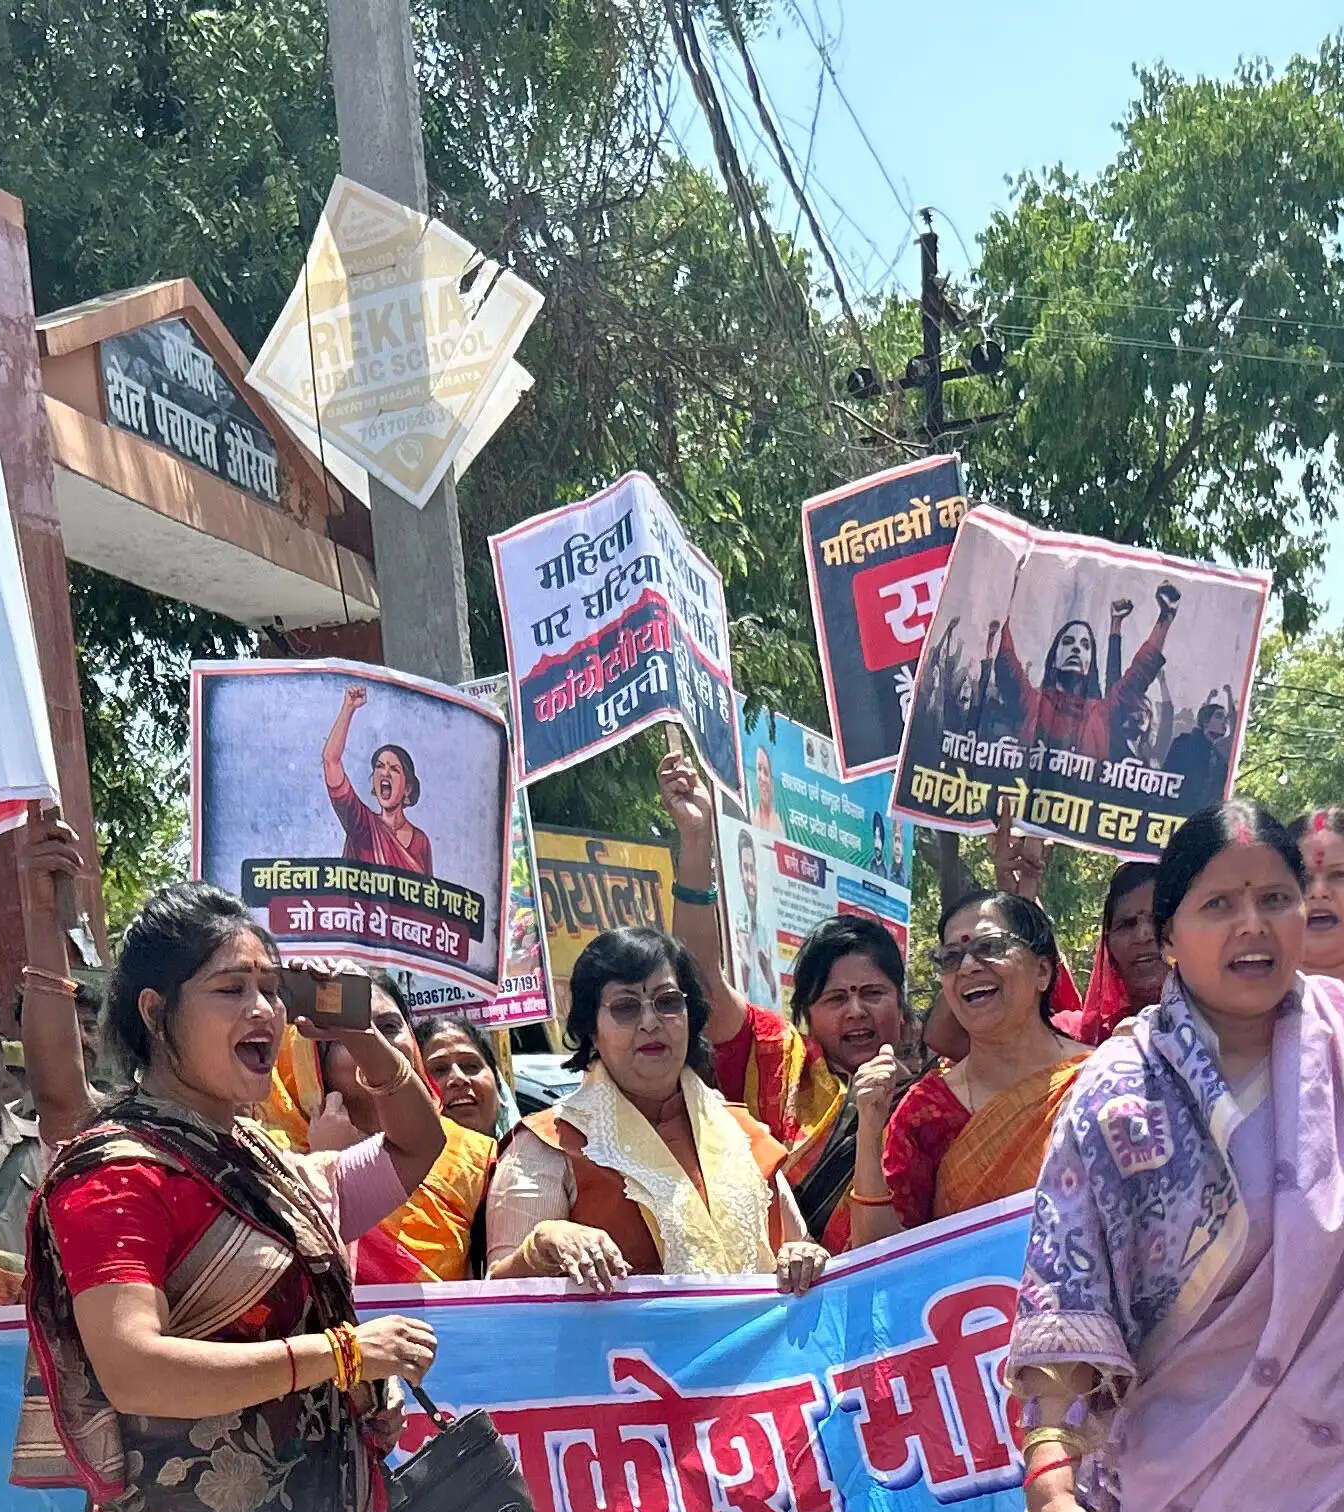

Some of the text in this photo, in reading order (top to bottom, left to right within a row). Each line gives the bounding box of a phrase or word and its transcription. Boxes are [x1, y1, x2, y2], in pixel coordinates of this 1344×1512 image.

[300, 329, 492, 400] PUBLIC SCHOOL
[311, 284, 470, 371] REKHA
[152, 382, 219, 473] पंचायत
[535, 508, 633, 590] महिला
[820, 494, 932, 567] महिलाओं
[531, 604, 571, 647] पर
[581, 554, 662, 620] घटिया
[596, 654, 668, 736] पुरानी
[910, 761, 992, 816] कांग्रेस
[1030, 787, 1094, 835] ठगा
[1097, 801, 1143, 844] हर
[1145, 810, 1188, 849] बा
[942, 730, 1185, 799] नारीशक्ति ने मांगा अधिकार
[252, 860, 320, 890] महिला
[324, 865, 396, 897] आरक्षण
[397, 879, 422, 903] पर
[422, 878, 440, 909] हो
[441, 888, 463, 916] गए
[287, 899, 460, 955] जो बनते थे बब्बर शेर
